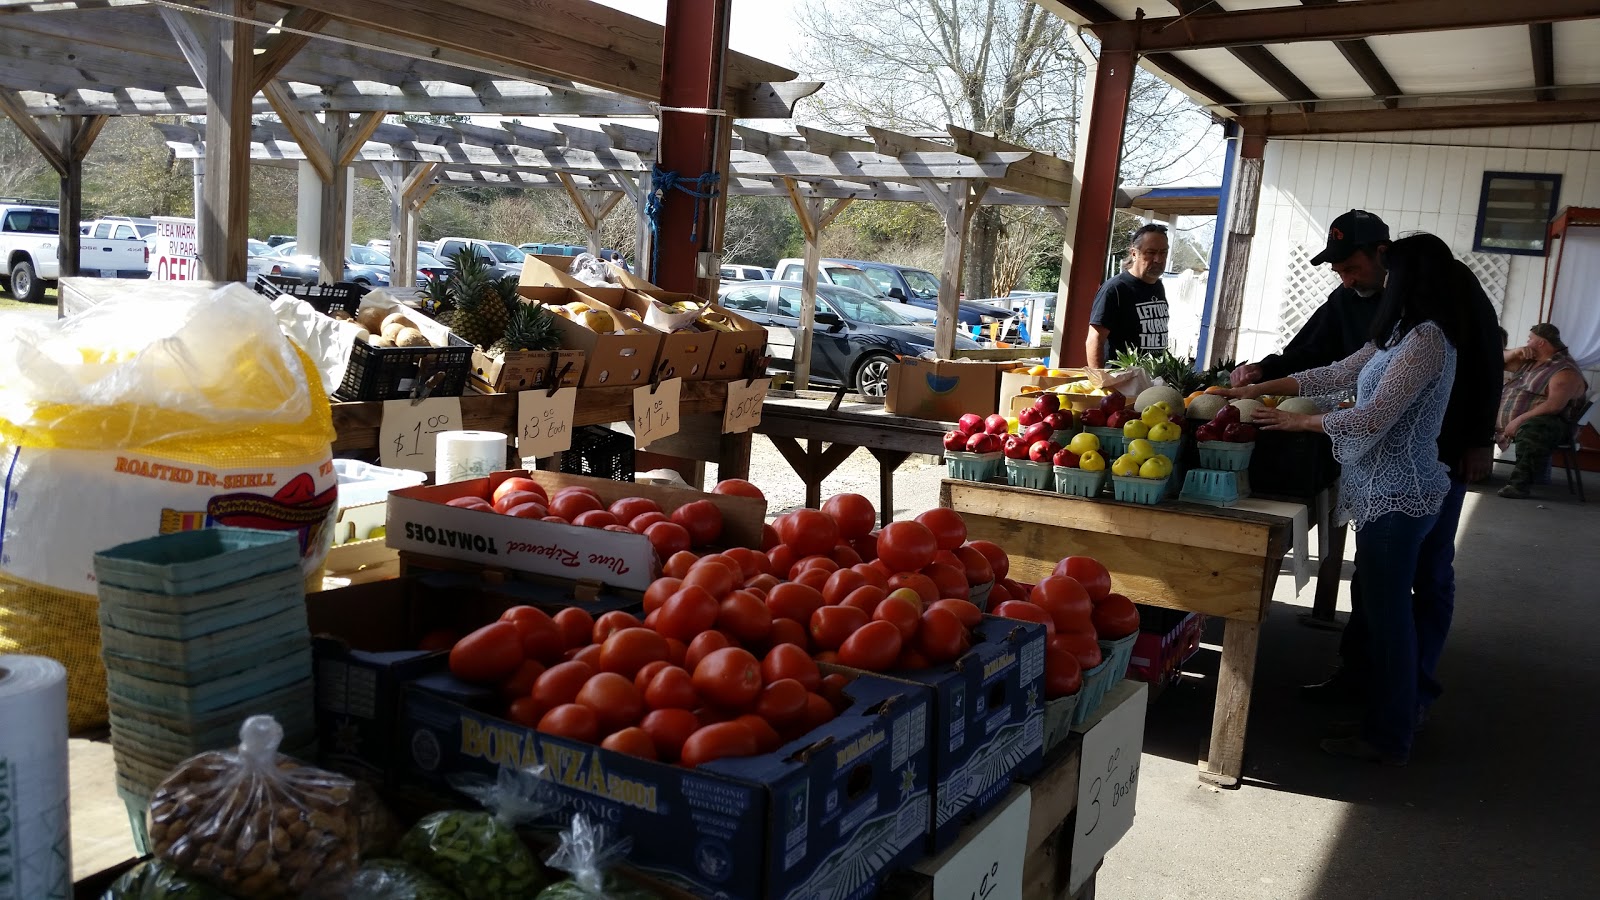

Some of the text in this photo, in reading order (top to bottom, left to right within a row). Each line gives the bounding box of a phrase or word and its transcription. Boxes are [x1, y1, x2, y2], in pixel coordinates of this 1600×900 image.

[158, 223, 174, 238] FLEA
[169, 241, 178, 254] RV
[1139, 334, 1160, 347] THE
[114, 456, 277, 489] ROASTED IN-SHELL
[404, 520, 630, 577] Vine Ripened TOMATOES
[459, 714, 609, 797] BONANZA
[608, 772, 657, 814] 2001
